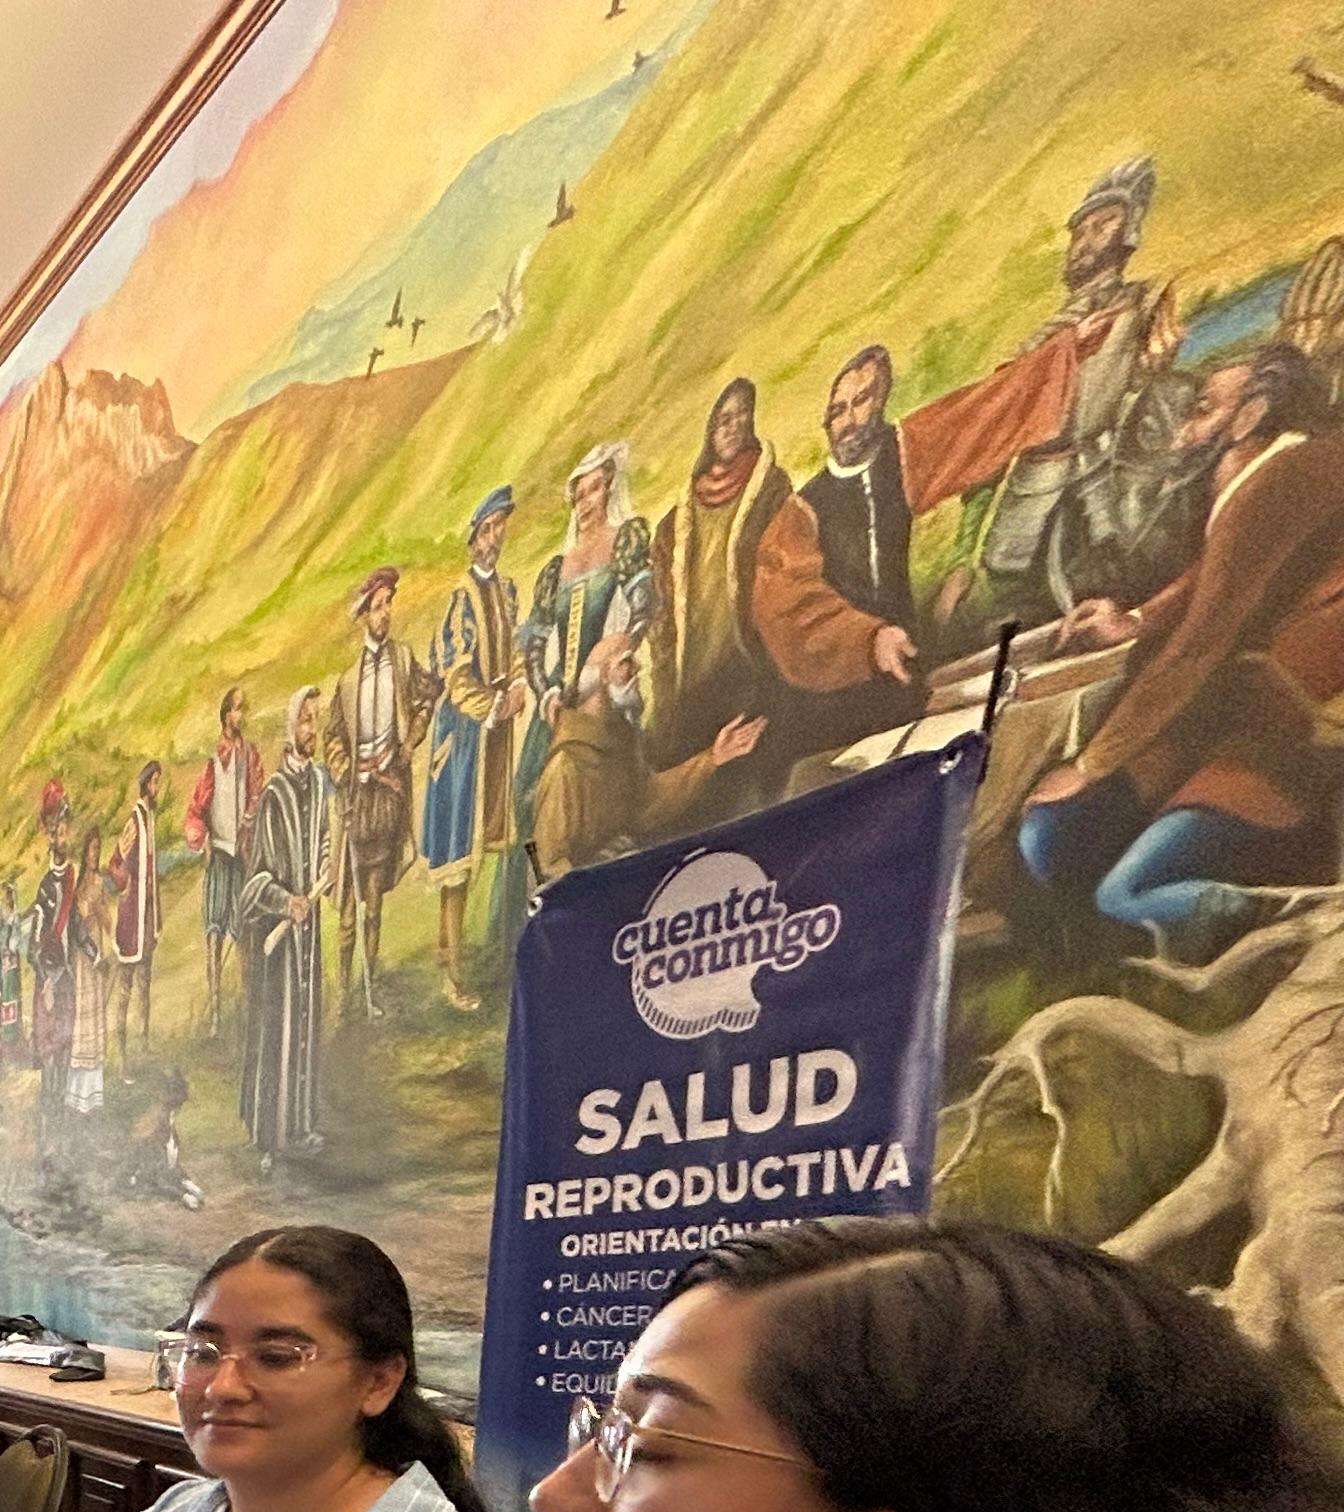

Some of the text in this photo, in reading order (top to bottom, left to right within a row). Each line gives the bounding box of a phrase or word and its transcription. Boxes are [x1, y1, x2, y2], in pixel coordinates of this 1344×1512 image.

[615, 884, 786, 960] cuenta
[642, 909, 836, 989] conmigo
[574, 1049, 859, 1155] SALUD
[523, 1141, 912, 1221] REPRODUCTIVA
[561, 1217, 745, 1257] ORIENTACIÓN
[554, 1340, 634, 1360] LACTA
